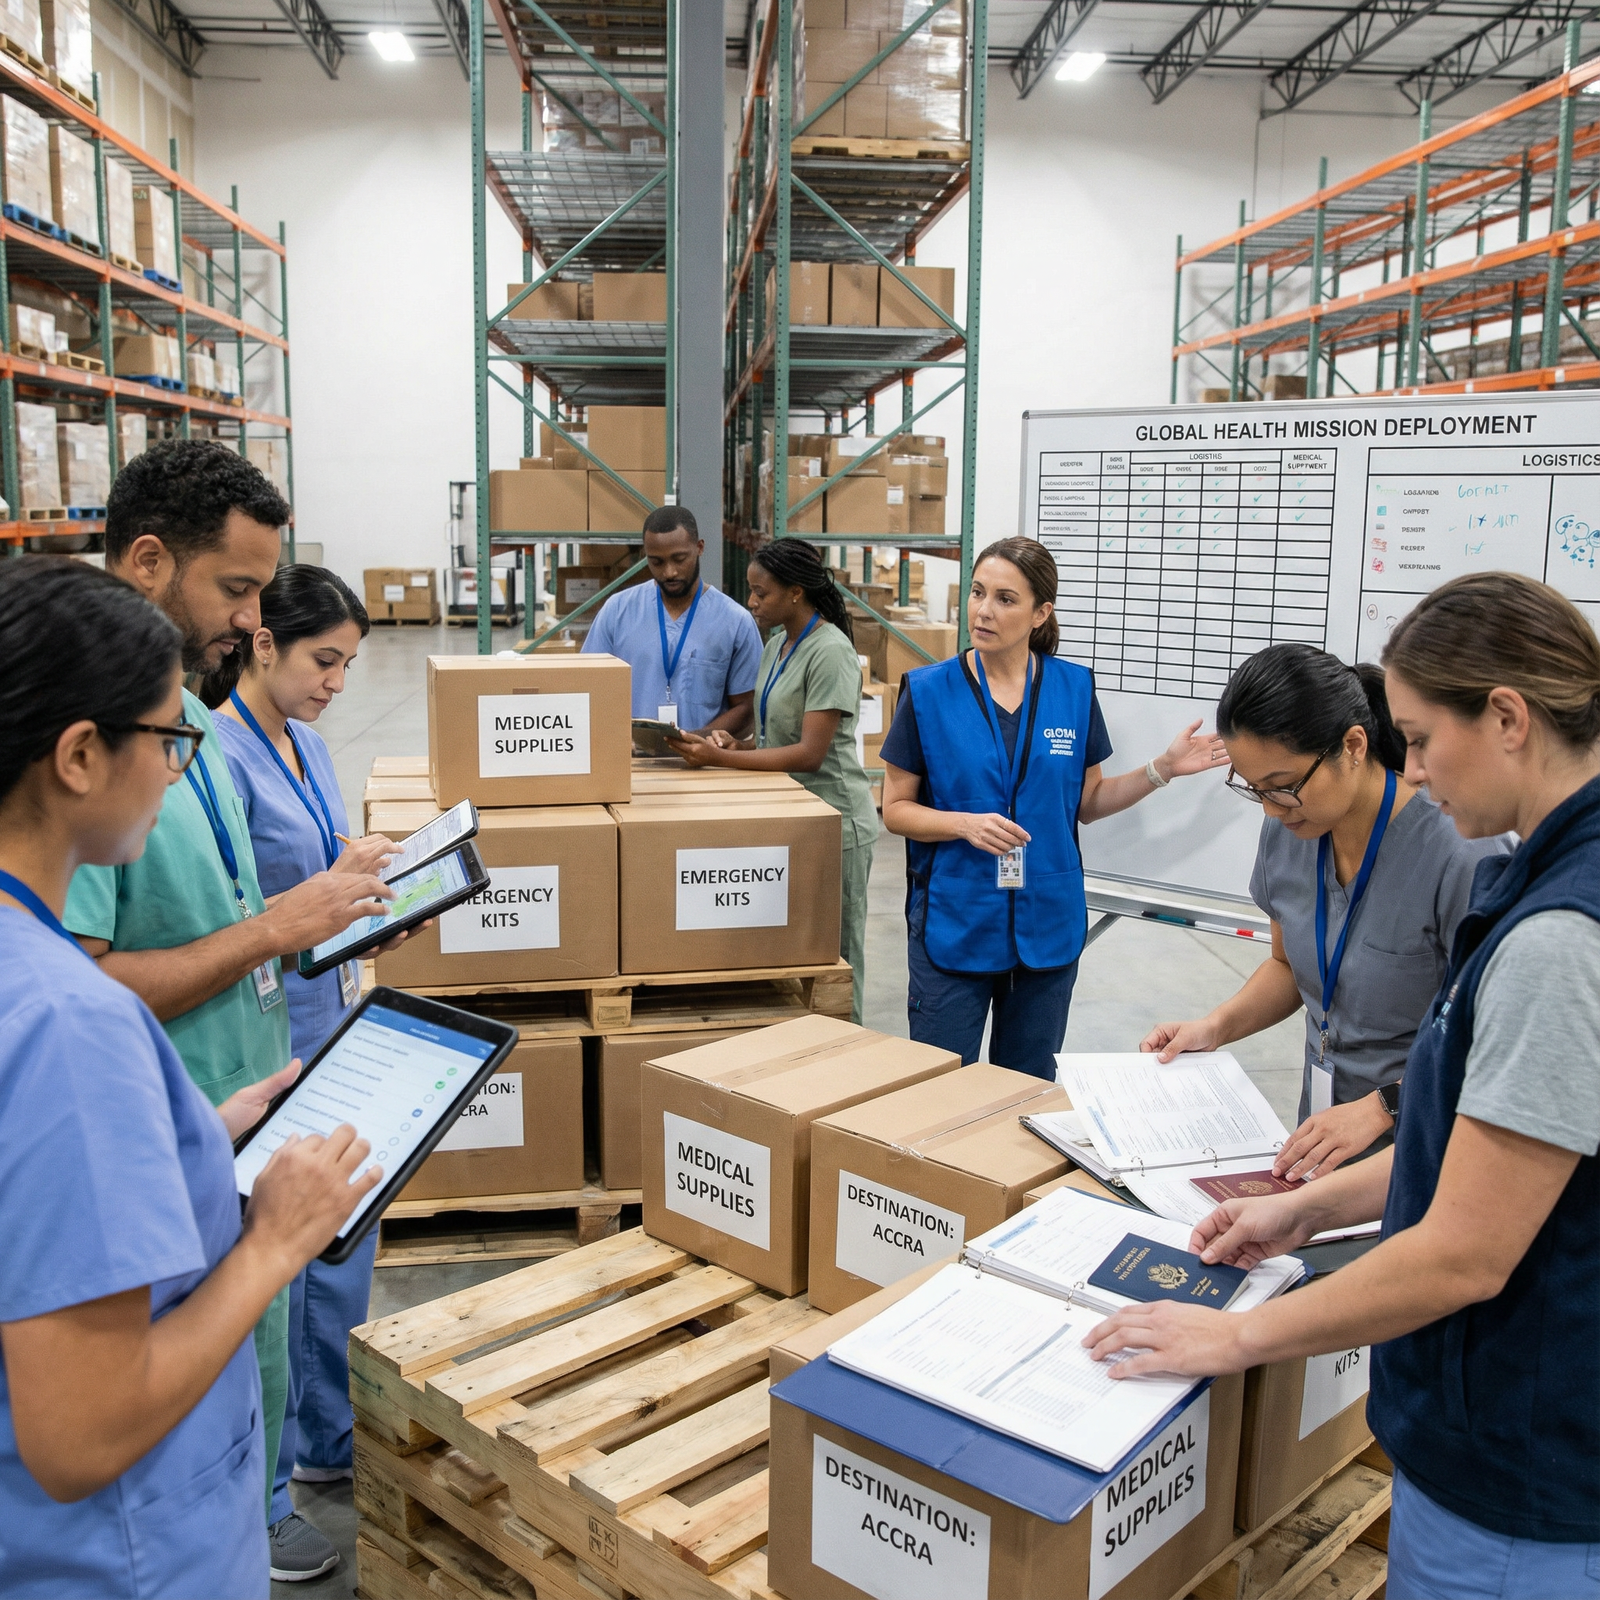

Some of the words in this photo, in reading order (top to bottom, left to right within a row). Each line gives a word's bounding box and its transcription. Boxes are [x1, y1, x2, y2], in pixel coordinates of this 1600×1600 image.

[1136, 424, 1208, 442] GLOBAL
[1214, 421, 1288, 440] HEALTH
[1293, 418, 1378, 438] MISSION
[1384, 414, 1538, 436] DEPLOYMENT
[1522, 453, 1600, 467] LOGISTICS
[495, 715, 573, 731] MEDICAL
[1043, 728, 1076, 740] GLOBAL
[495, 738, 574, 754] SUPPLIES
[681, 866, 785, 885] EMERGENCY
[461, 887, 554, 905] ERGENCY
[715, 891, 751, 907] KITS
[481, 912, 520, 928] KITS
[677, 1141, 754, 1187] MEDICAL
[677, 1171, 755, 1218] SUPPLIES
[847, 1184, 954, 1239] DESTINATION:
[872, 1223, 925, 1256] ACCRA
[1334, 1347, 1360, 1379] KITS
[1107, 1424, 1196, 1513] MEDICAL
[825, 1456, 976, 1547] DESTINATION:
[1104, 1464, 1195, 1557] SUPPLIES
[861, 1513, 933, 1566] ACCRA
